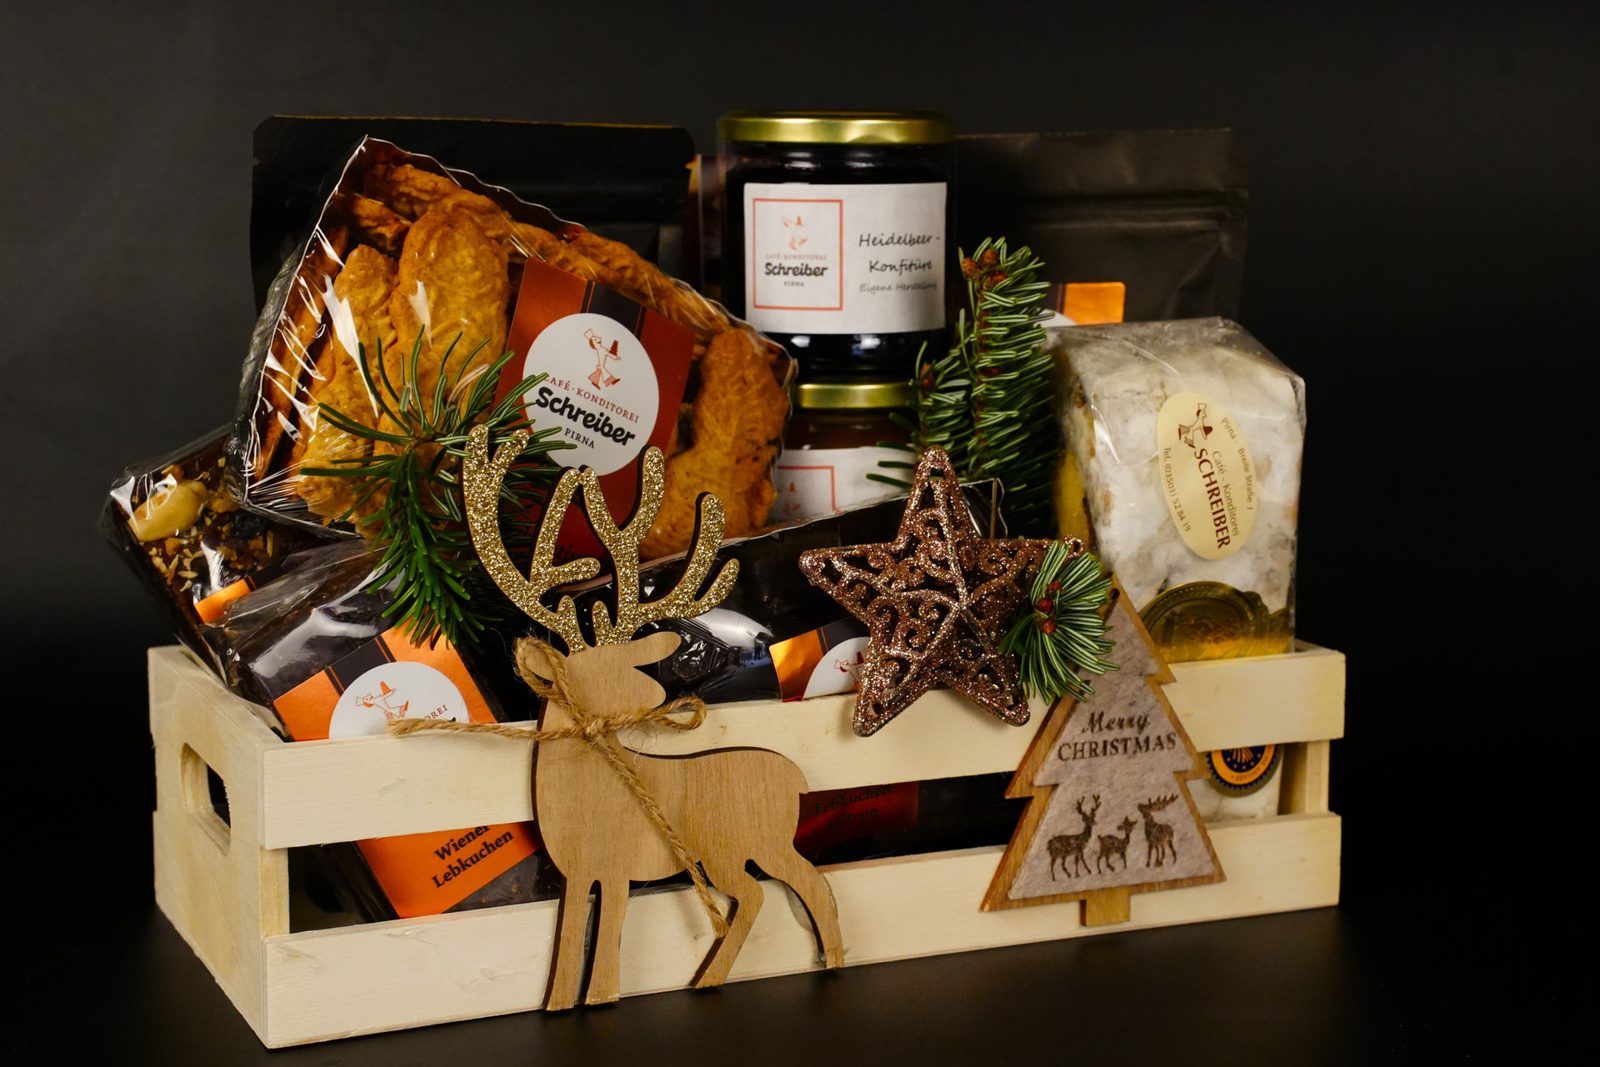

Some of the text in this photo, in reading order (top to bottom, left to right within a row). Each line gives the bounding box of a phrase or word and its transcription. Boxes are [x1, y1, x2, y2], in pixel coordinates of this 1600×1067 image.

[764, 262, 829, 277] Schreiber
[868, 258, 933, 277] Konfitüre
[535, 386, 636, 446] Schreiber
[575, 387, 640, 424] KONDITOREI
[564, 428, 595, 449] PIRNA
[1193, 448, 1231, 550] SCHREIBER
[1212, 450, 1227, 475] Café
[1222, 483, 1240, 537] Konditorei
[1081, 711, 1151, 734] Merry
[1057, 732, 1177, 762] CHRISTMAS
[431, 831, 514, 889] Lebkuchen
